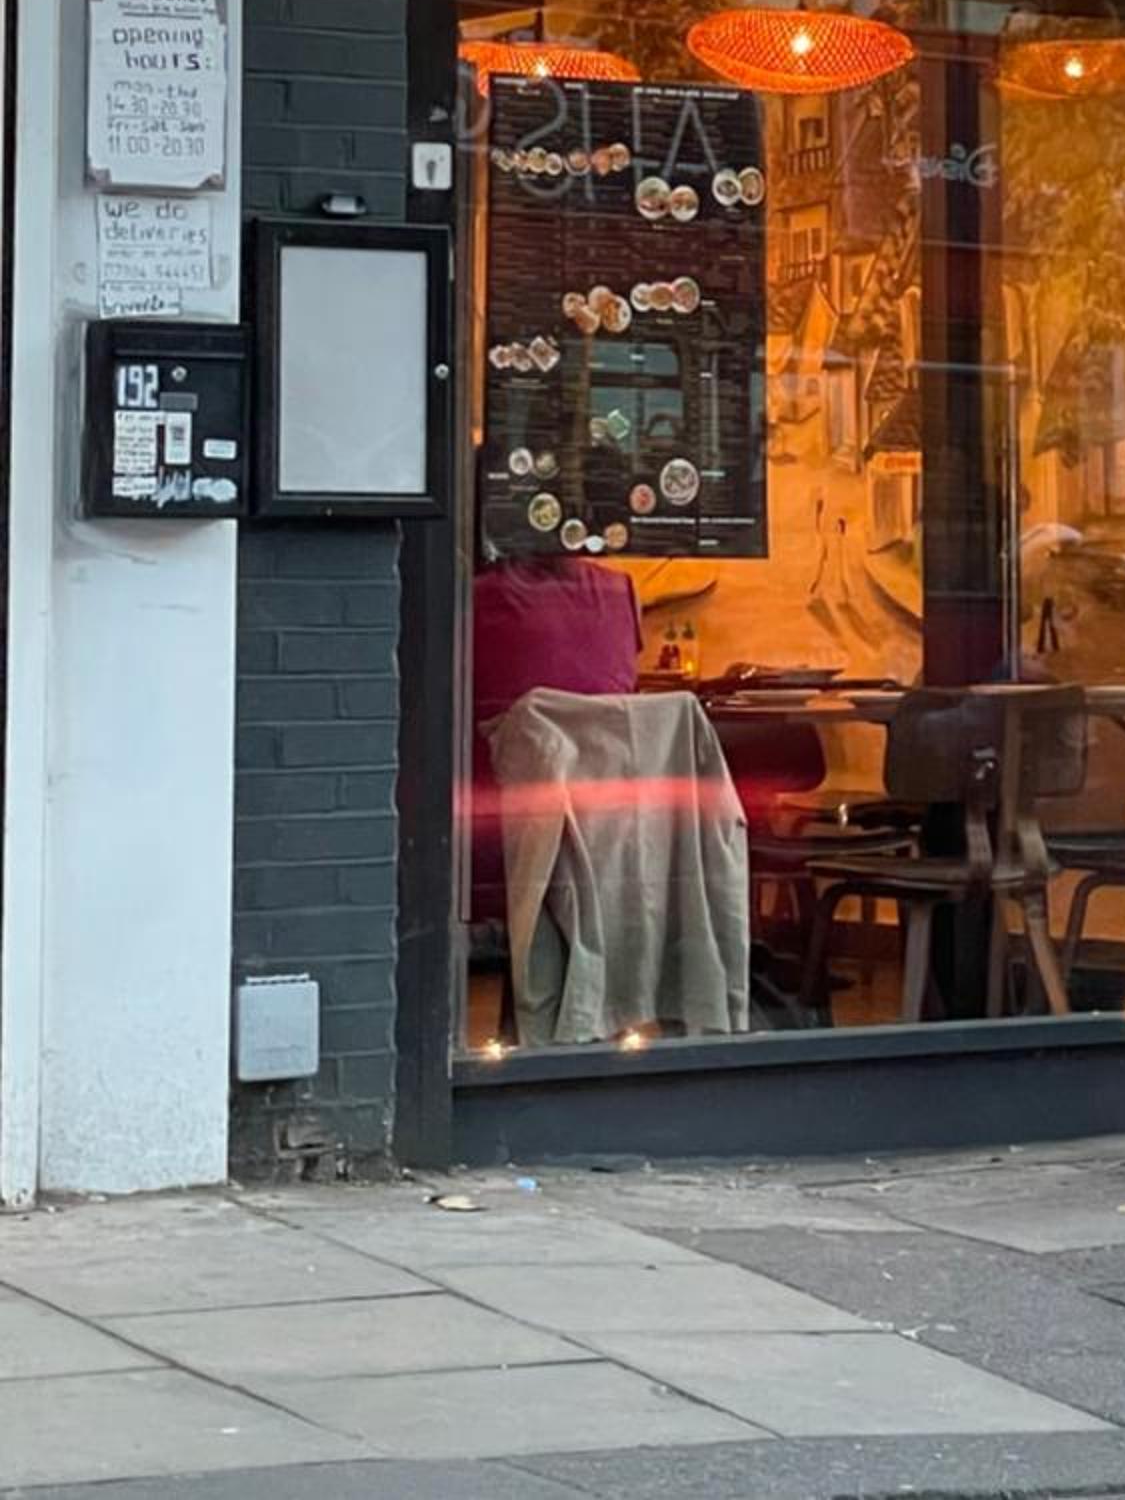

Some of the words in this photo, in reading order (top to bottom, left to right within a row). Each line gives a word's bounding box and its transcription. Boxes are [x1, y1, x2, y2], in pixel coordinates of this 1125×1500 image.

[112, 27, 203, 50] opening
[155, 200, 189, 220] do
[104, 220, 208, 245] deliveries
[116, 365, 160, 408] 192
